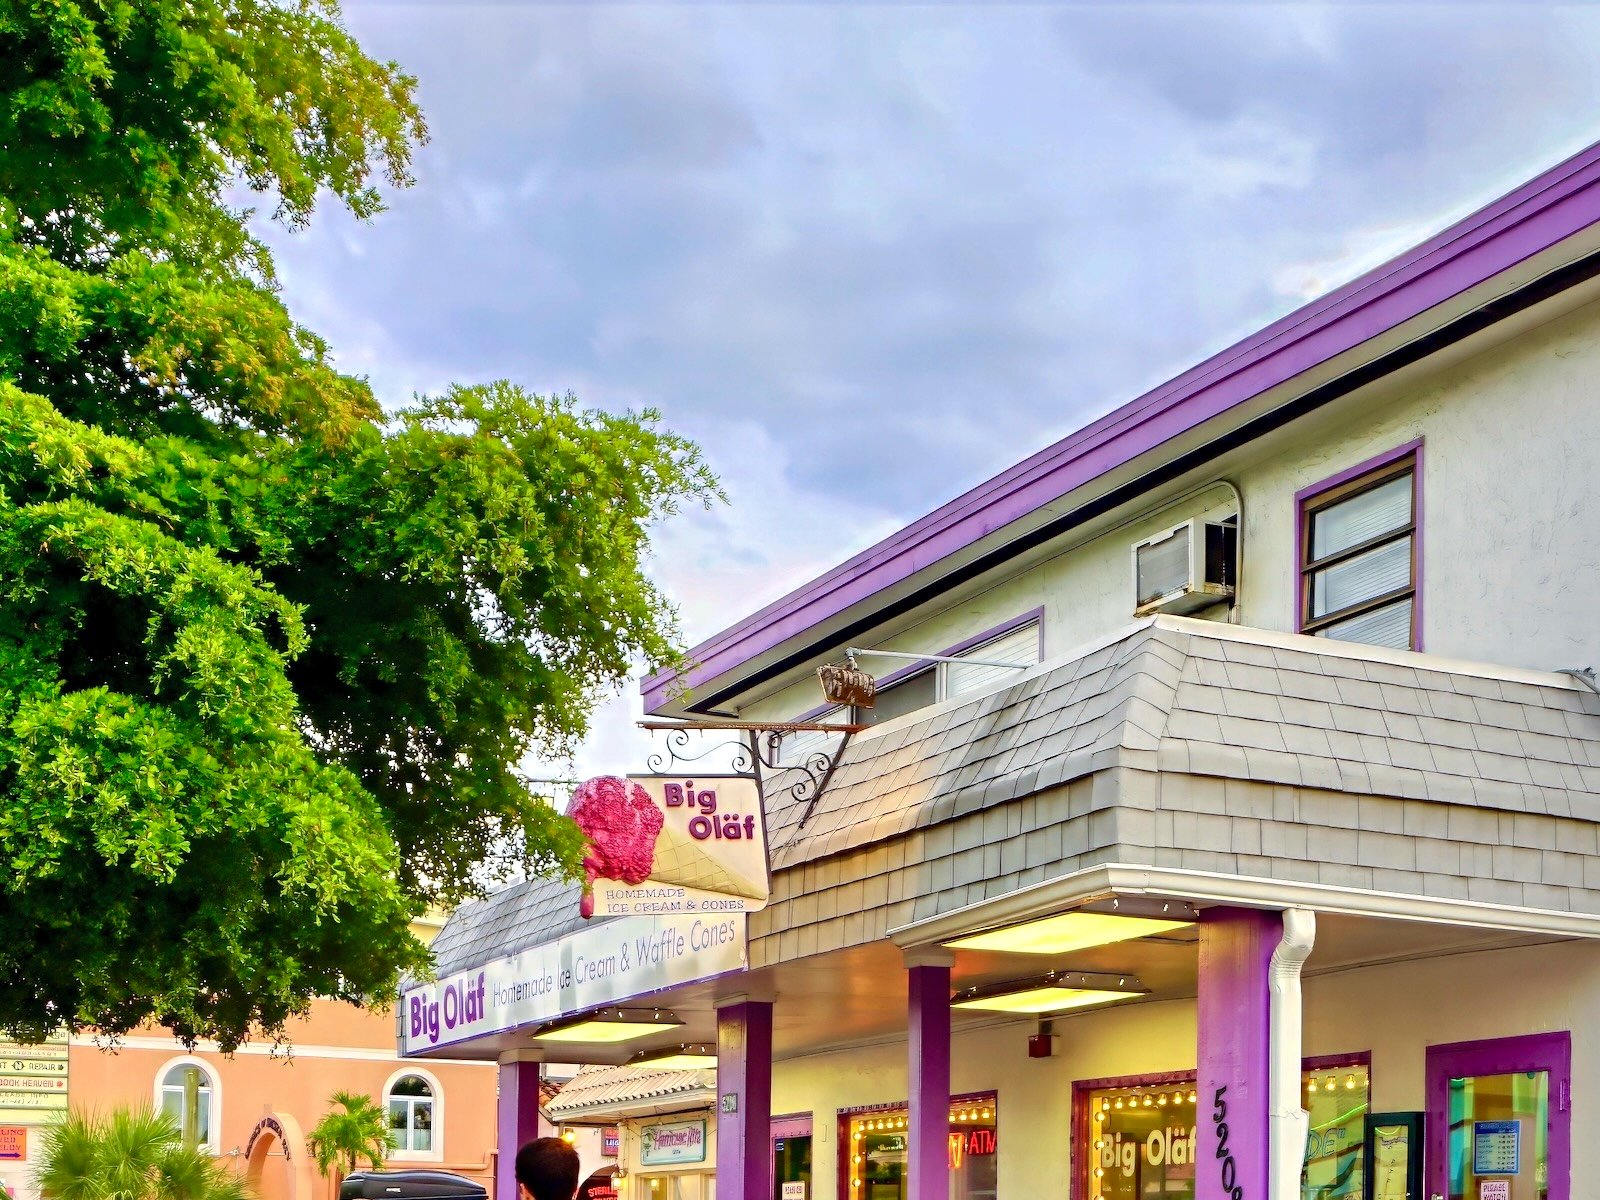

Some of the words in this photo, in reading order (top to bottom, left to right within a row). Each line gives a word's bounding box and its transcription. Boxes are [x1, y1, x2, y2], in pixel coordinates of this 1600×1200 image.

[664, 780, 717, 814] Big
[689, 814, 755, 840] Oläf
[606, 888, 685, 900] HOMEMADE
[607, 903, 629, 913] ICE
[634, 901, 681, 912] CREAM
[686, 900, 696, 910] &
[701, 900, 744, 910] CONES
[411, 993, 439, 1043] Big
[444, 971, 485, 1030] Oläf
[493, 968, 553, 1008] Homemade
[557, 961, 571, 989] Ice
[575, 956, 616, 984] Cream
[620, 942, 630, 972] &
[636, 927, 685, 966] Waffle
[690, 920, 735, 951] Cones
[968, 1130, 996, 1155] ATM
[1101, 1132, 1136, 1177] Big
[1146, 1125, 1197, 1166] Oläf
[1483, 1184, 1506, 1192] PLEASE
